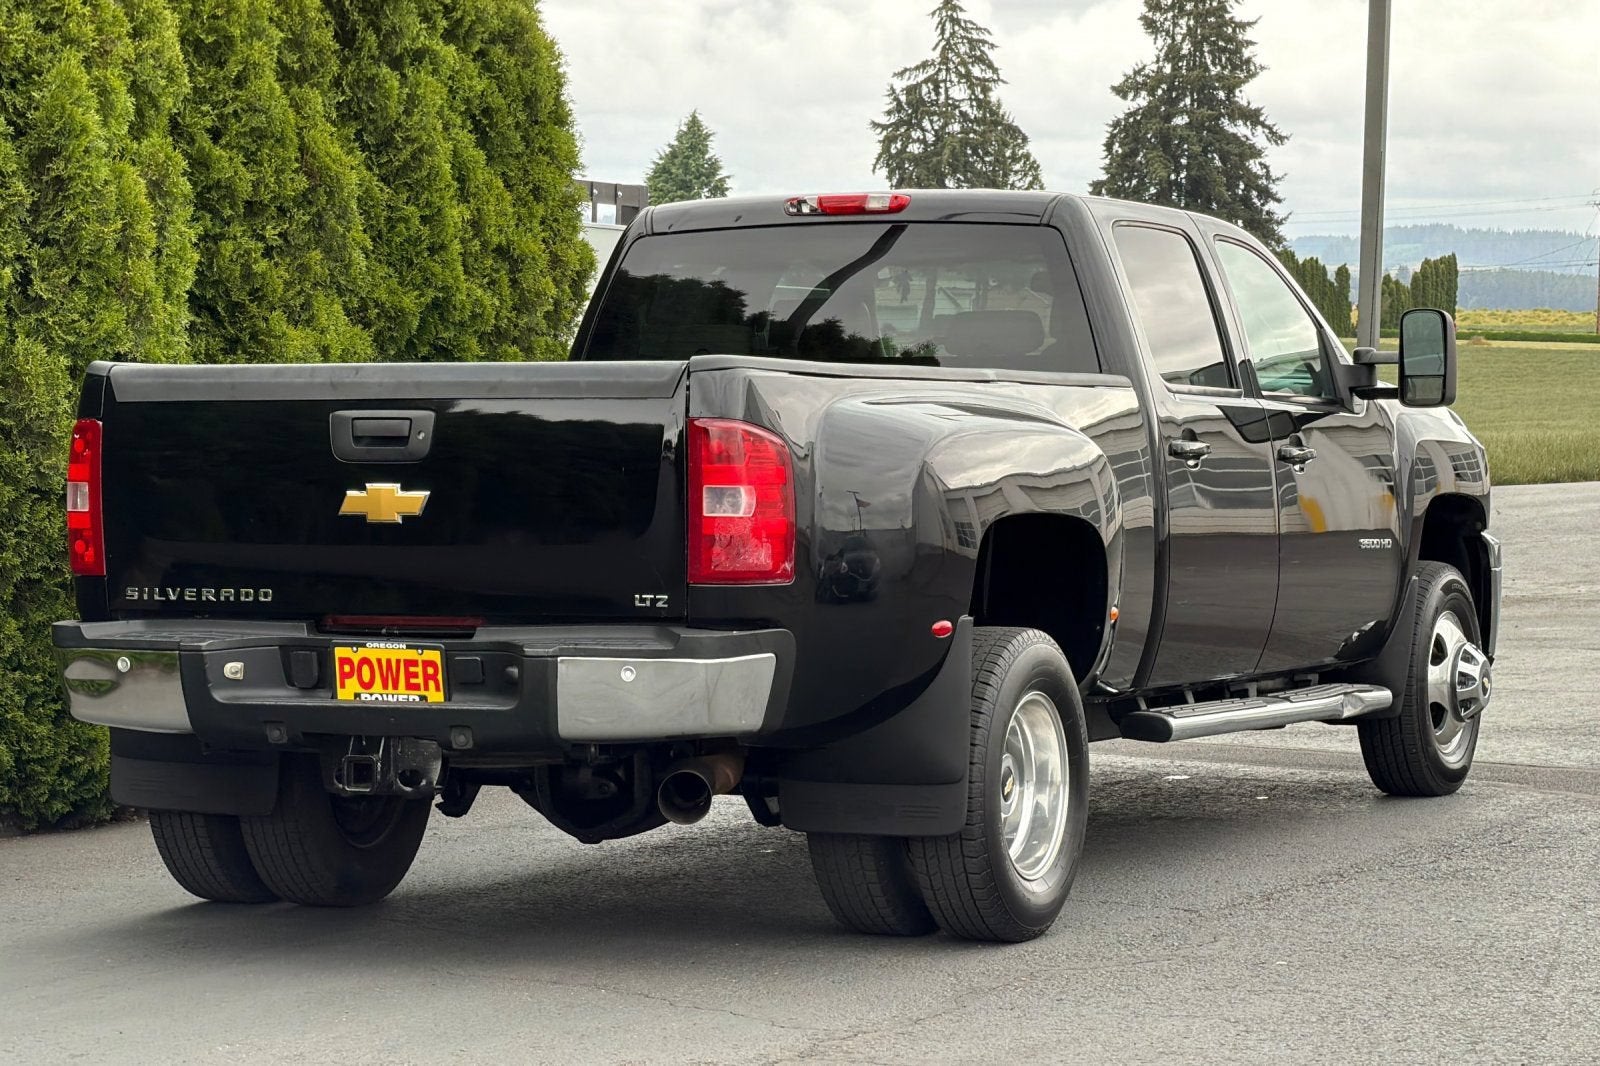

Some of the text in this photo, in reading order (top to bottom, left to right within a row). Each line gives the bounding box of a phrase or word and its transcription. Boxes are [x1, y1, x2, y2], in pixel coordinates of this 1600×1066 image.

[125, 587, 273, 602] SILVERADO
[634, 594, 669, 608] LTZ
[365, 642, 407, 650] OREGON
[337, 656, 442, 692] POWER
